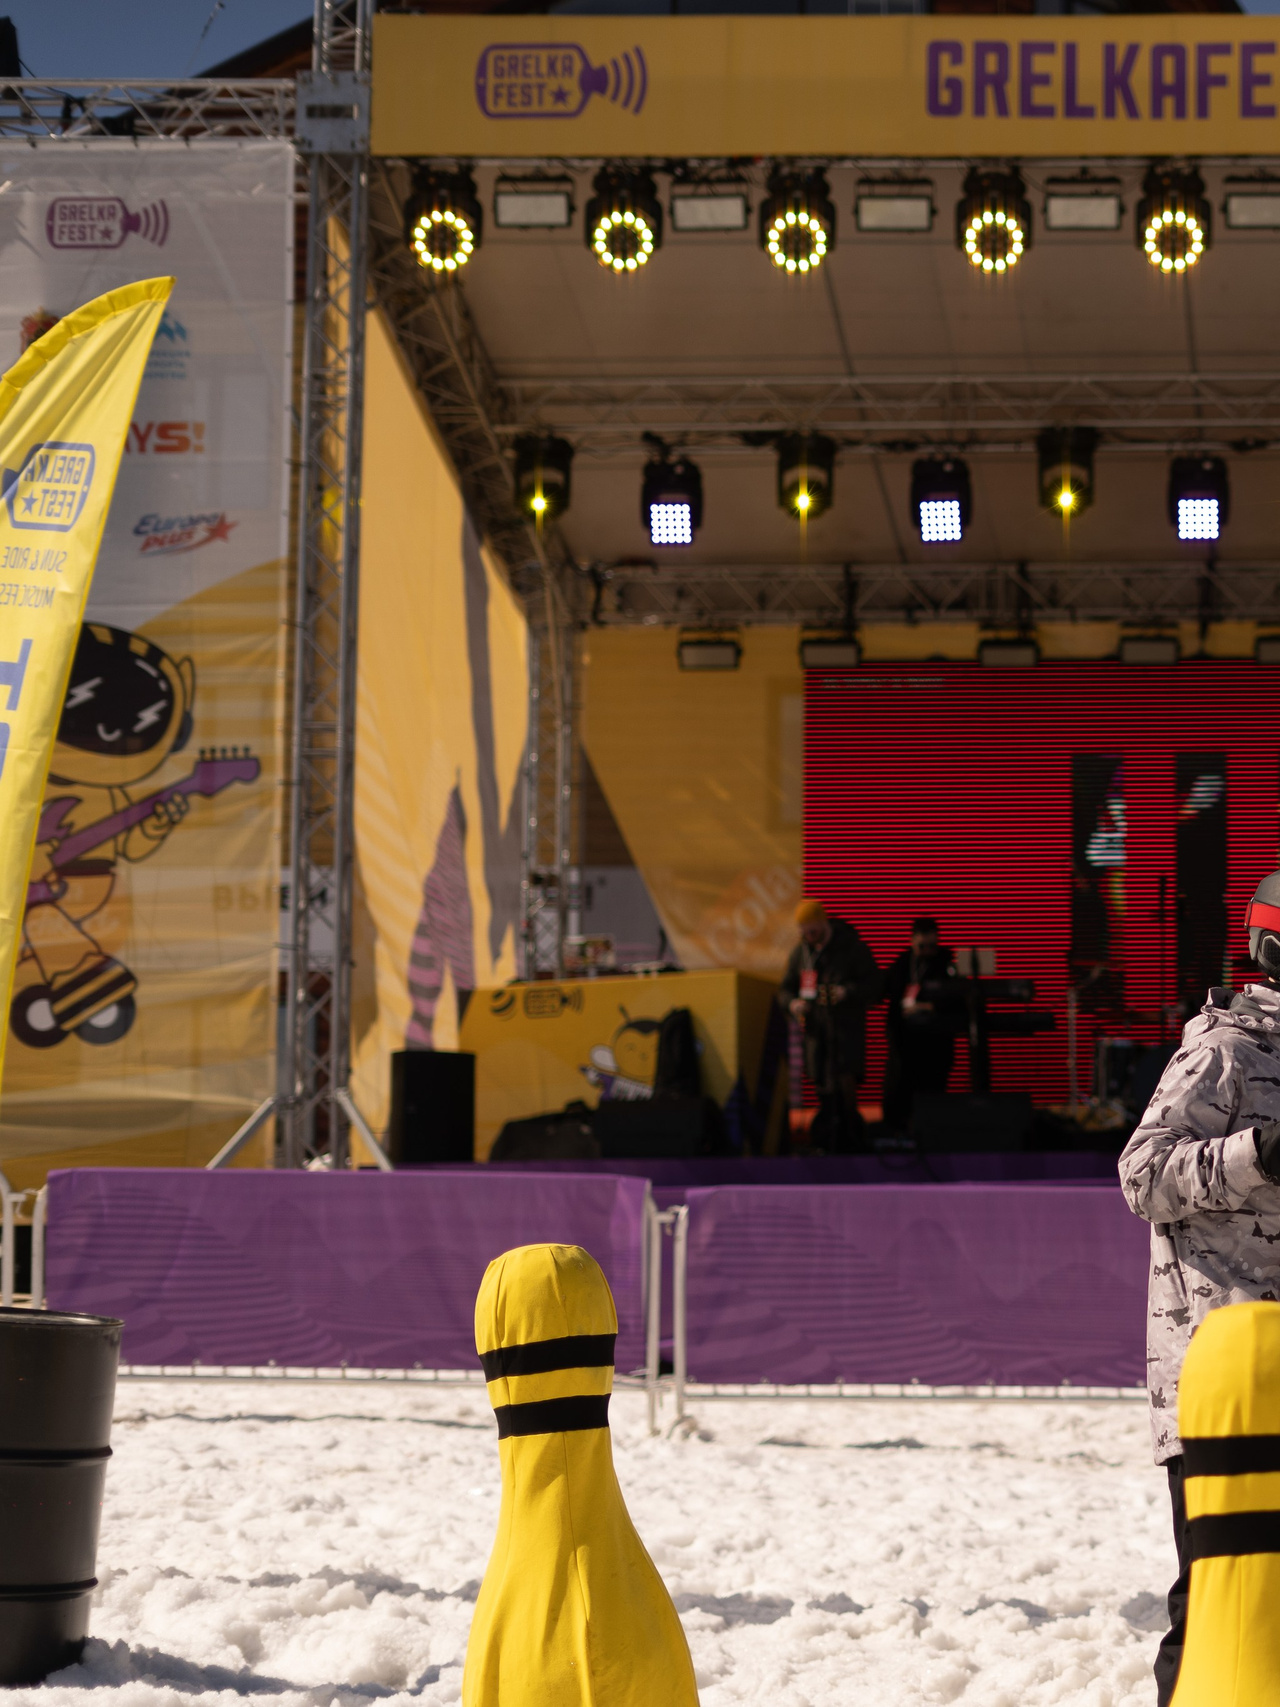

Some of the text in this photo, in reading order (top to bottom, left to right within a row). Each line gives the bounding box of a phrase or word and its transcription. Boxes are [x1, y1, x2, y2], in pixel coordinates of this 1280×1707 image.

[493, 54, 574, 78] GRELKA
[493, 83, 547, 107] FEST
[59, 204, 117, 221] GRELKA
[59, 224, 98, 241] FEST
